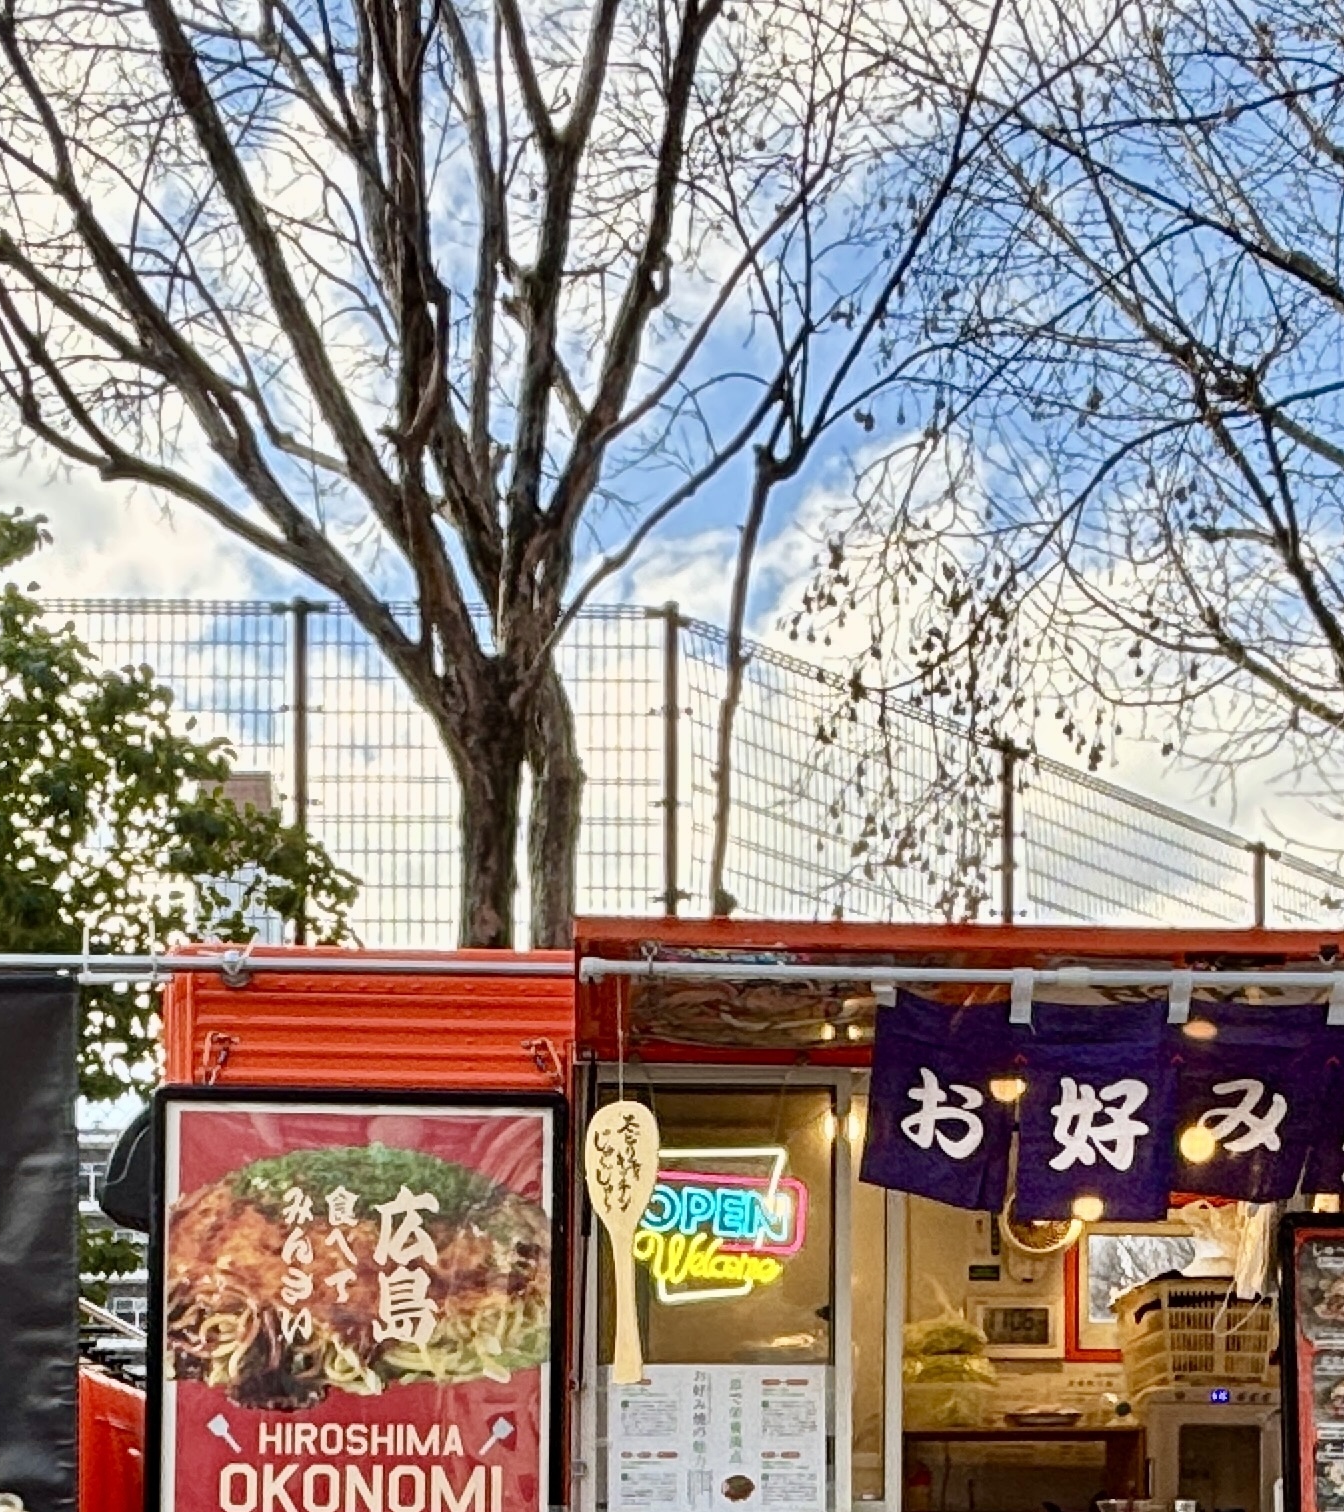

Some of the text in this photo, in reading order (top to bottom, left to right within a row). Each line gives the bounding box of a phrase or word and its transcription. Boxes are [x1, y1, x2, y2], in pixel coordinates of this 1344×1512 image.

[325, 1186, 358, 1303] 食べて
[639, 1184, 792, 1242] OPEN
[373, 1185, 441, 1345] 広島
[259, 1422, 464, 1456] HIROSHIMA
